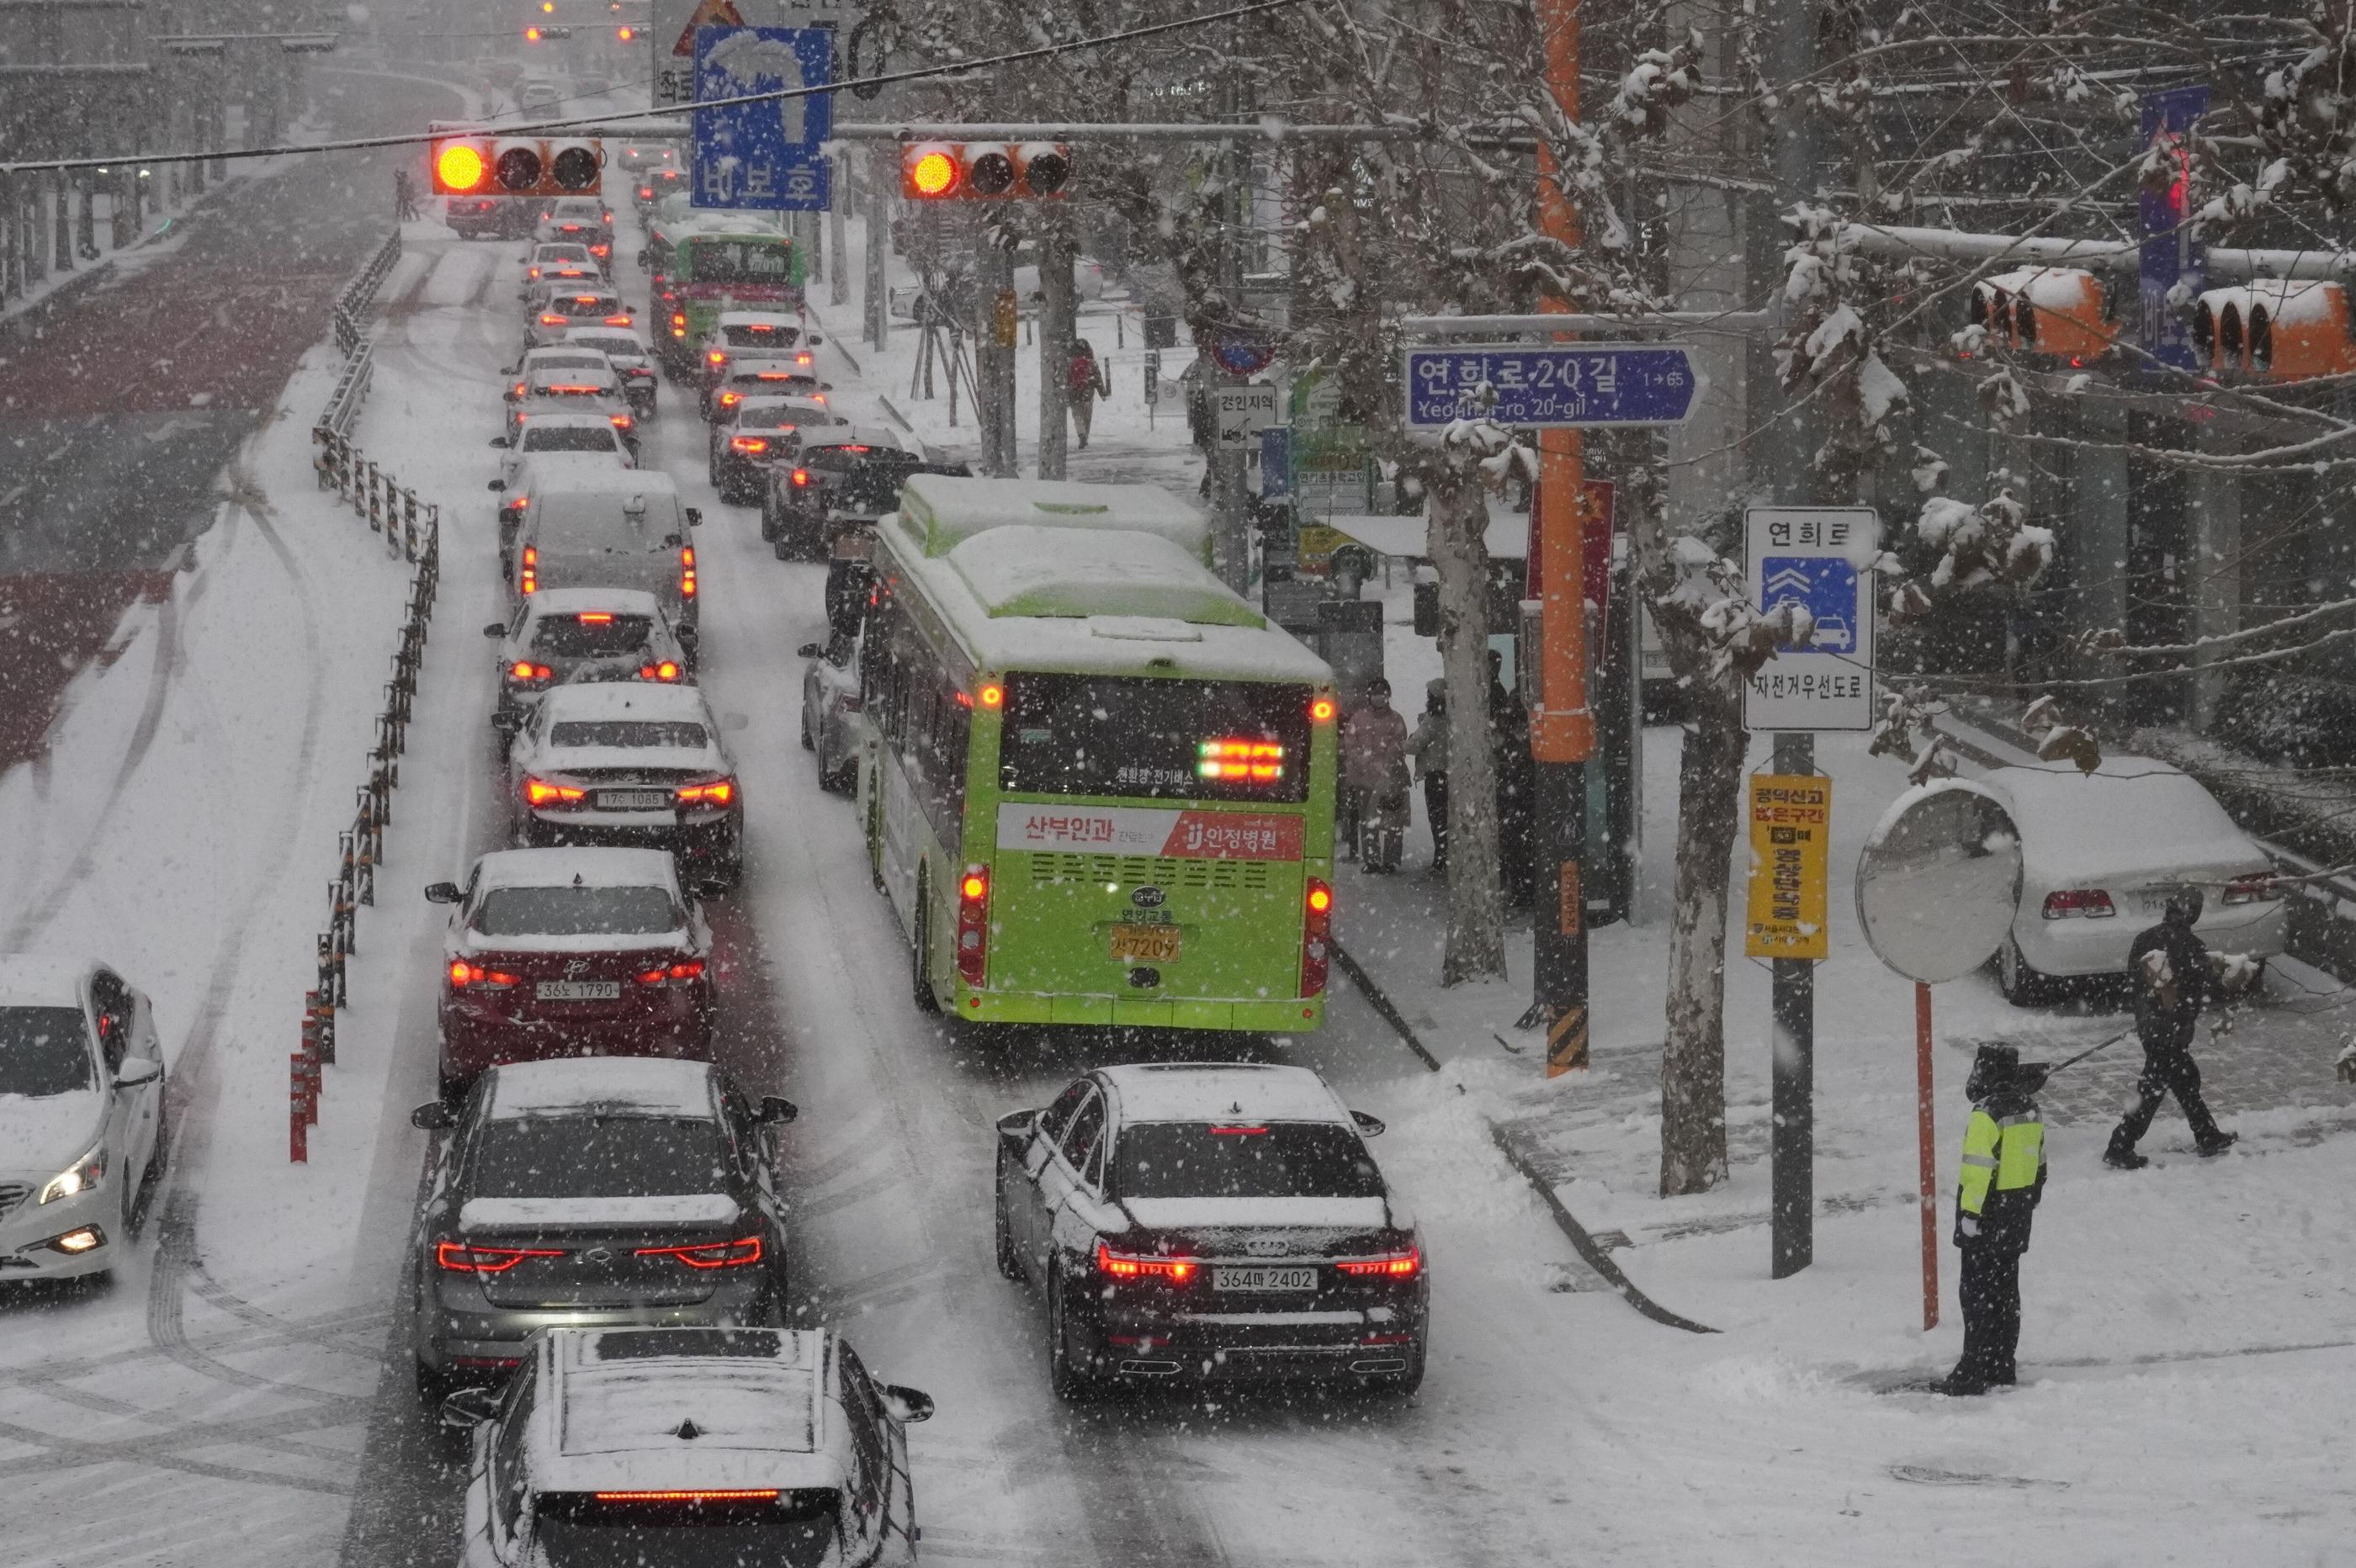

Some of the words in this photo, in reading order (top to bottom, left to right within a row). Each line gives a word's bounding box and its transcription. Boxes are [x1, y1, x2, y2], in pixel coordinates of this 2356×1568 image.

[702, 160, 820, 202] 비보호
[1419, 356, 1617, 395] 연희로20길
[1667, 372, 1685, 386] 65
[1222, 395, 1274, 410] 견인지역
[1533, 398, 1586, 419] 20-gil
[1768, 522, 1850, 547] 연희로
[1755, 675, 1862, 699] 자전거우선도로
[1154, 771, 1194, 786] 전기버스
[1026, 816, 1115, 842] 산부인과
[1207, 829, 1276, 851] 인정병원
[578, 983, 613, 996] 1790
[1269, 1271, 1313, 1287] 2402
